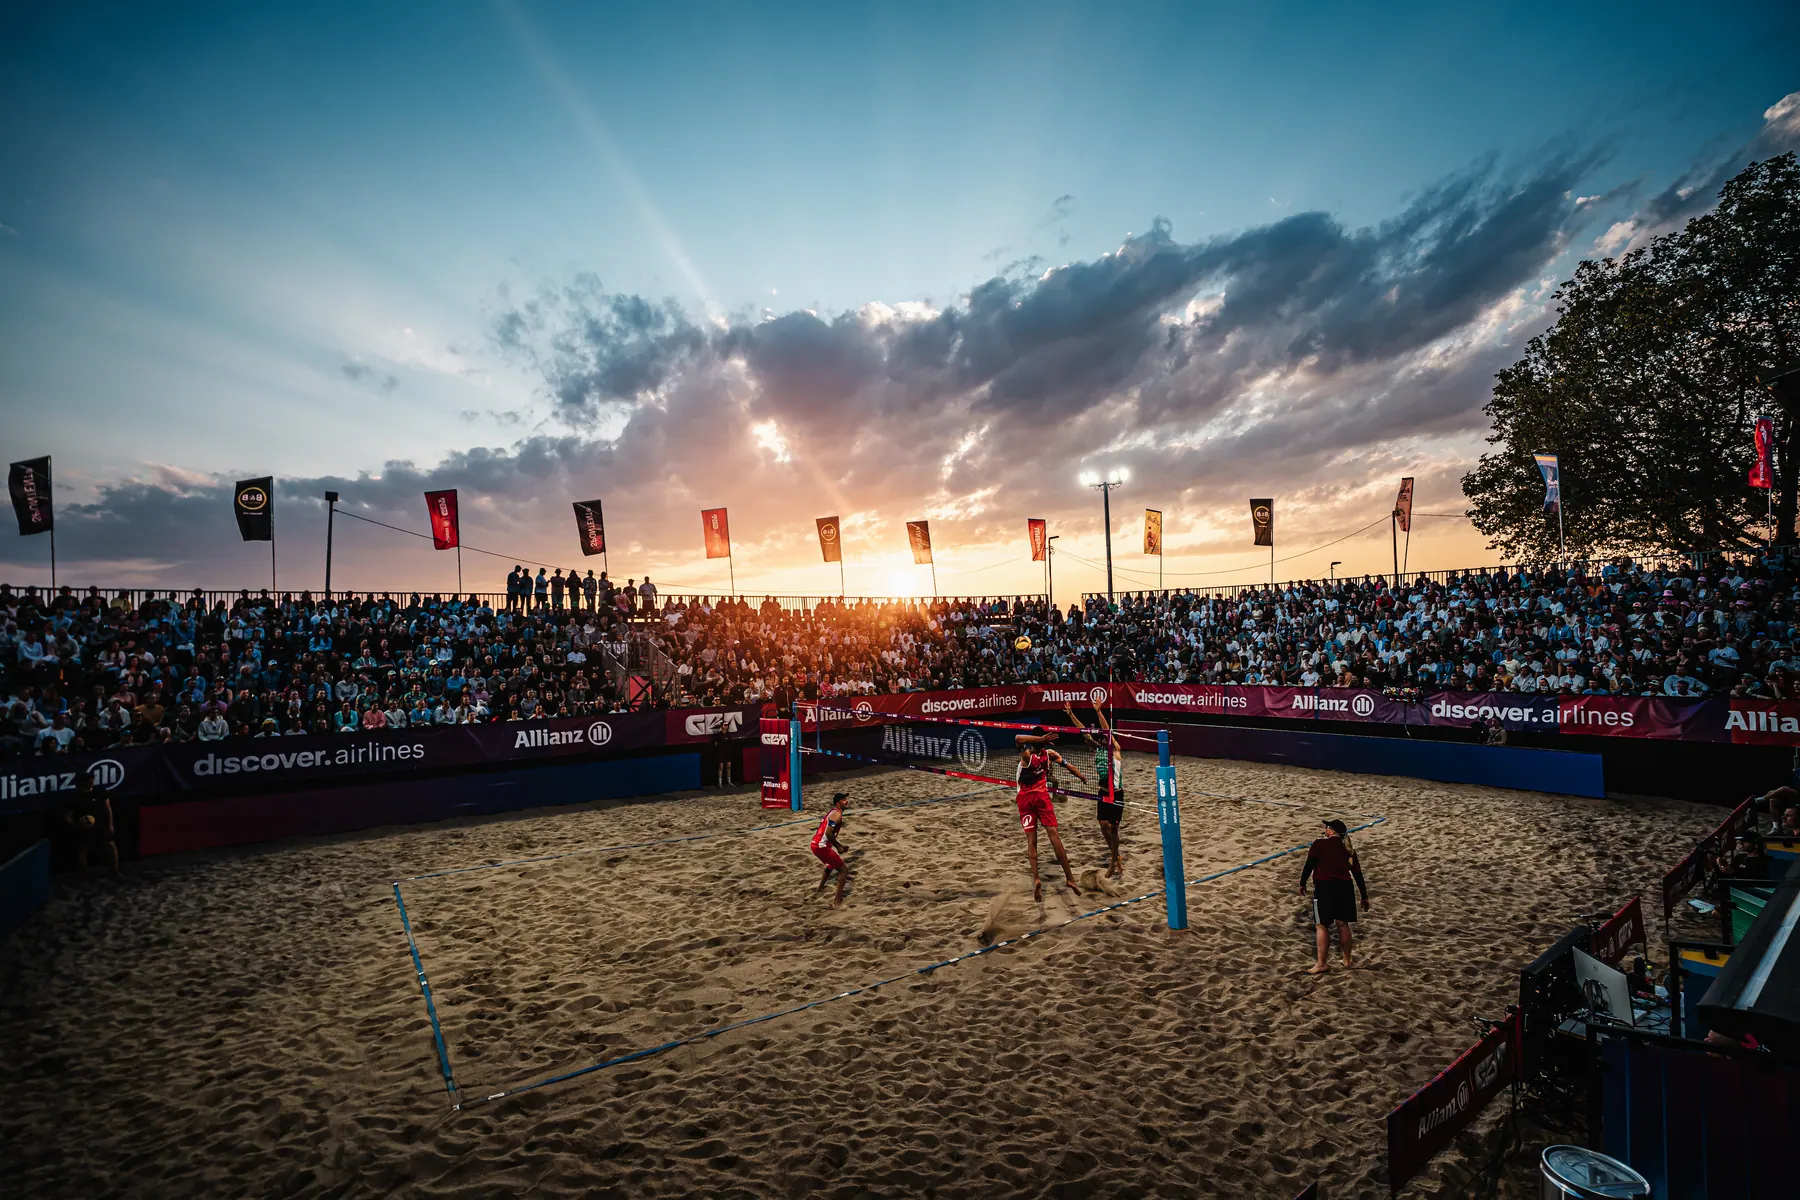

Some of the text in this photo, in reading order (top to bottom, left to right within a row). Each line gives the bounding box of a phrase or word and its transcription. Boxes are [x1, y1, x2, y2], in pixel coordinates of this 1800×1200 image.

[1041, 689, 1088, 703] Allianz
[1291, 694, 1349, 712] Allianz
[514, 728, 584, 748] Allianz
[881, 725, 952, 760] Allianz
[1418, 1096, 1458, 1140] Allianz
